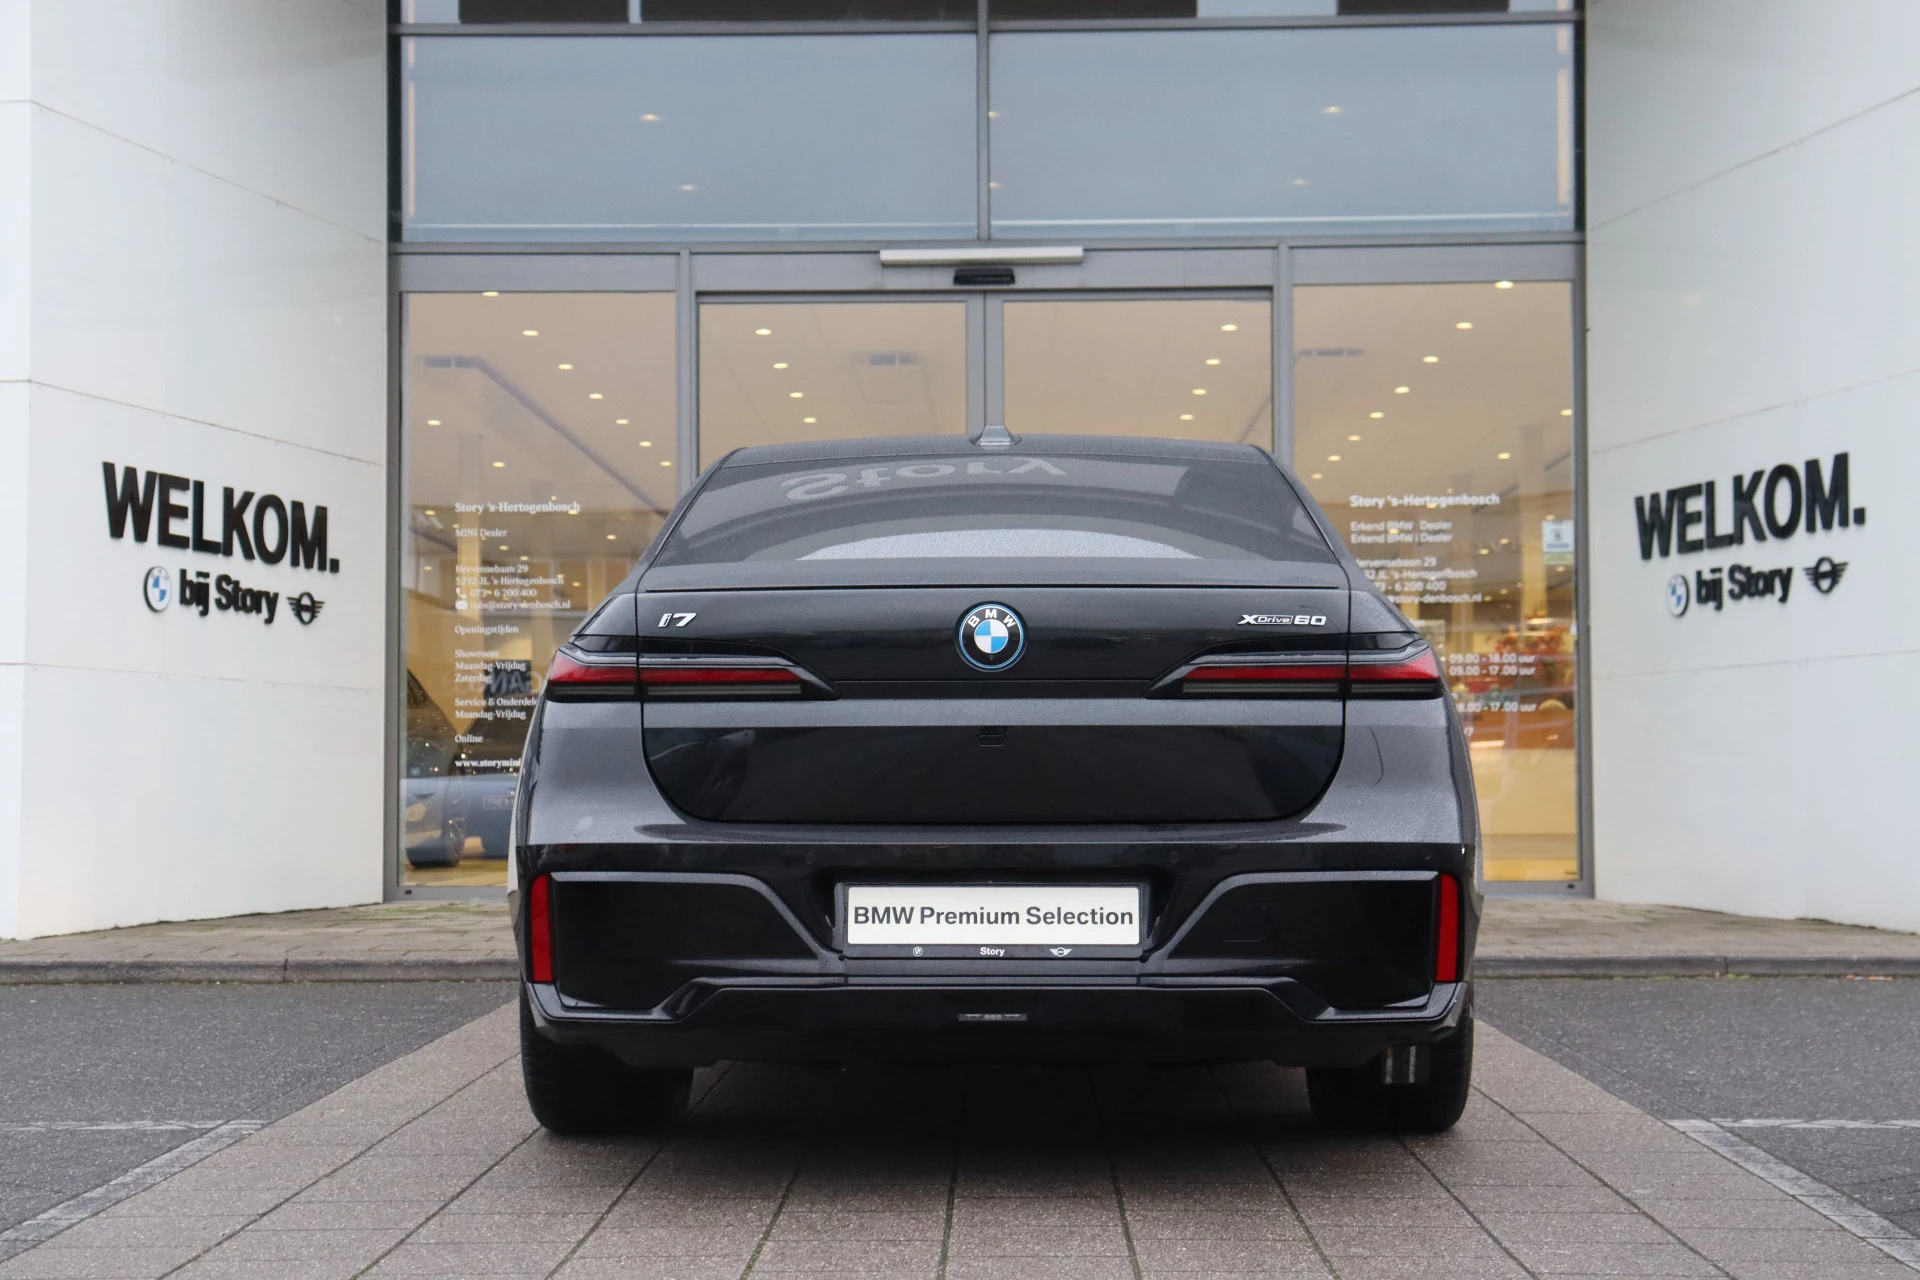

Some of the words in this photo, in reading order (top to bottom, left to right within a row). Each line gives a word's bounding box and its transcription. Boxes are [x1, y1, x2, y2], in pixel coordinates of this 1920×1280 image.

[1350, 494, 1384, 508] Story
[1634, 452, 1866, 560] WELKOM.
[455, 502, 484, 514] Story
[102, 461, 340, 574] WELKOM.
[1351, 521, 1384, 531] Erkend
[1387, 521, 1414, 531] BMW
[1420, 520, 1453, 530] Dealer
[455, 528, 477, 537] MINI
[480, 528, 507, 537] Dealer
[1351, 533, 1384, 543] Erkend
[1387, 533, 1413, 543] BMW
[1420, 532, 1452, 542] Dealer
[1424, 556, 1437, 567] 29
[517, 564, 528, 573] 29
[1403, 581, 1423, 592] 200
[1426, 581, 1446, 592] 400
[1695, 567, 1724, 611] bij
[1728, 564, 1793, 604] Story
[179, 568, 209, 617] bij
[215, 574, 279, 625] Story
[494, 589, 500, 598] 6
[502, 589, 518, 598] 200
[520, 588, 537, 598] 400
[658, 612, 697, 627] i7
[967, 608, 1016, 628] BMW
[455, 624, 518, 635] Openingstijden
[455, 649, 499, 658] Showroom
[1449, 654, 1480, 663] 09.00
[1518, 655, 1535, 663] uur
[1449, 665, 1480, 676] 09.00
[1519, 667, 1536, 675] uur
[455, 673, 492, 684] Zaterdag
[455, 697, 486, 706] Service
[1520, 703, 1537, 711] uur
[455, 734, 483, 743] Online
[853, 906, 914, 925] BMW
[920, 906, 1020, 925] Premium
[1026, 906, 1133, 925] Selection
[980, 947, 1005, 957] Story
